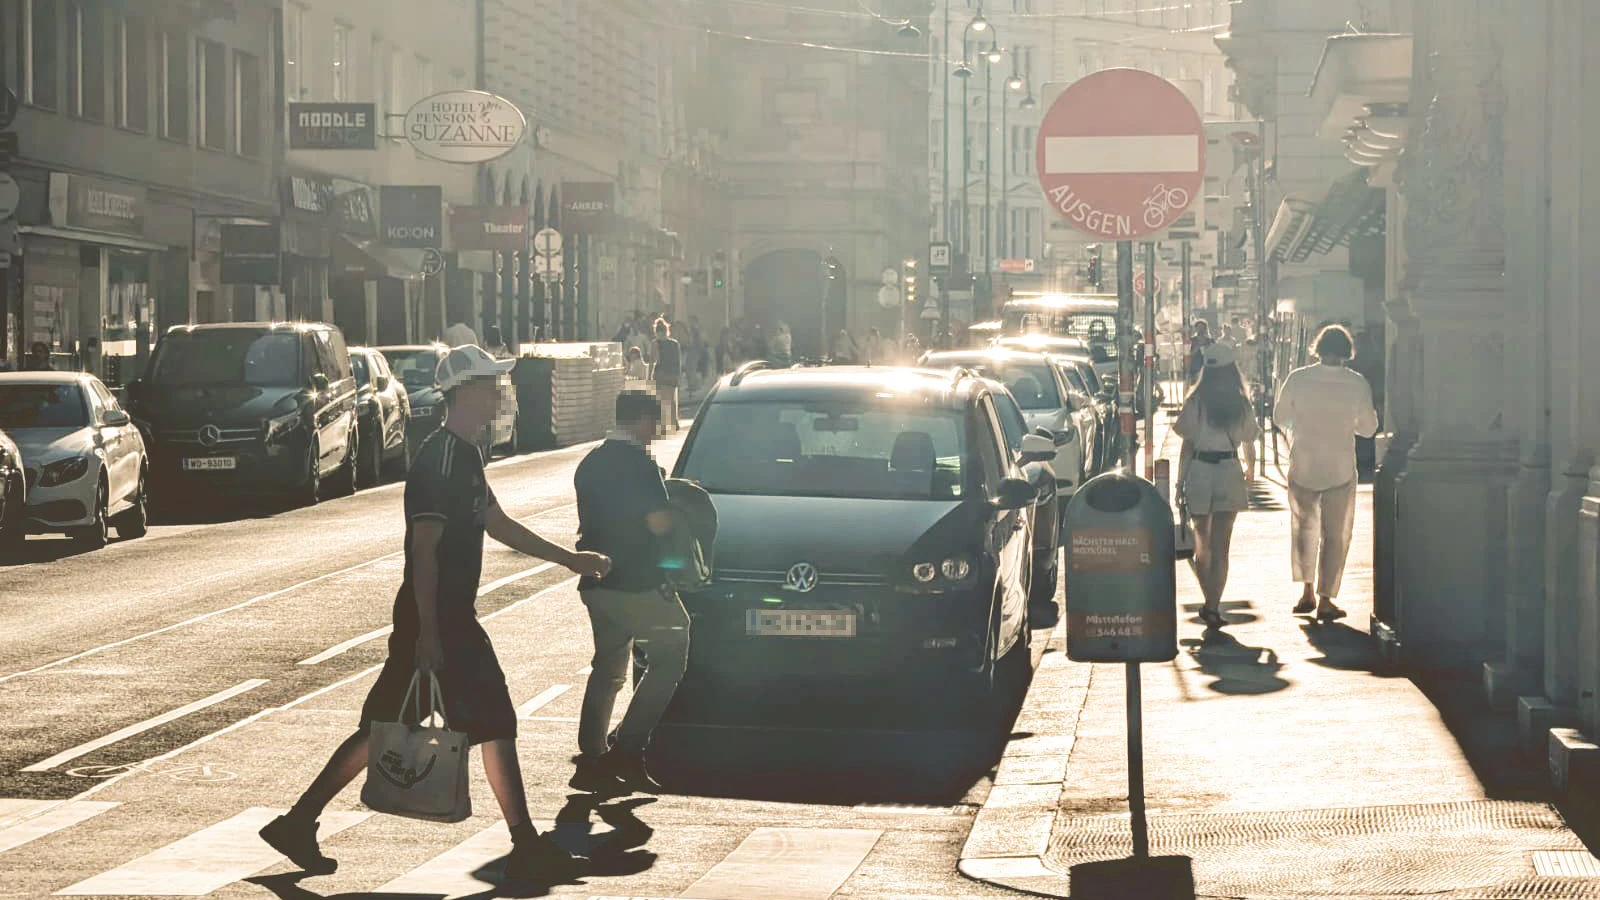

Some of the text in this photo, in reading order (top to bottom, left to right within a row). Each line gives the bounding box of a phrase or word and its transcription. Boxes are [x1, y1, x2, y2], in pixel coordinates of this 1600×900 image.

[431, 102, 476, 113] HOTEL
[299, 112, 366, 127] NOODLE
[416, 112, 476, 123] PENSION
[411, 124, 517, 143] SUZANNE
[1049, 184, 1137, 235] AUSGEN.
[483, 222, 525, 233] Theater
[1085, 613, 1143, 625] Misttelefon
